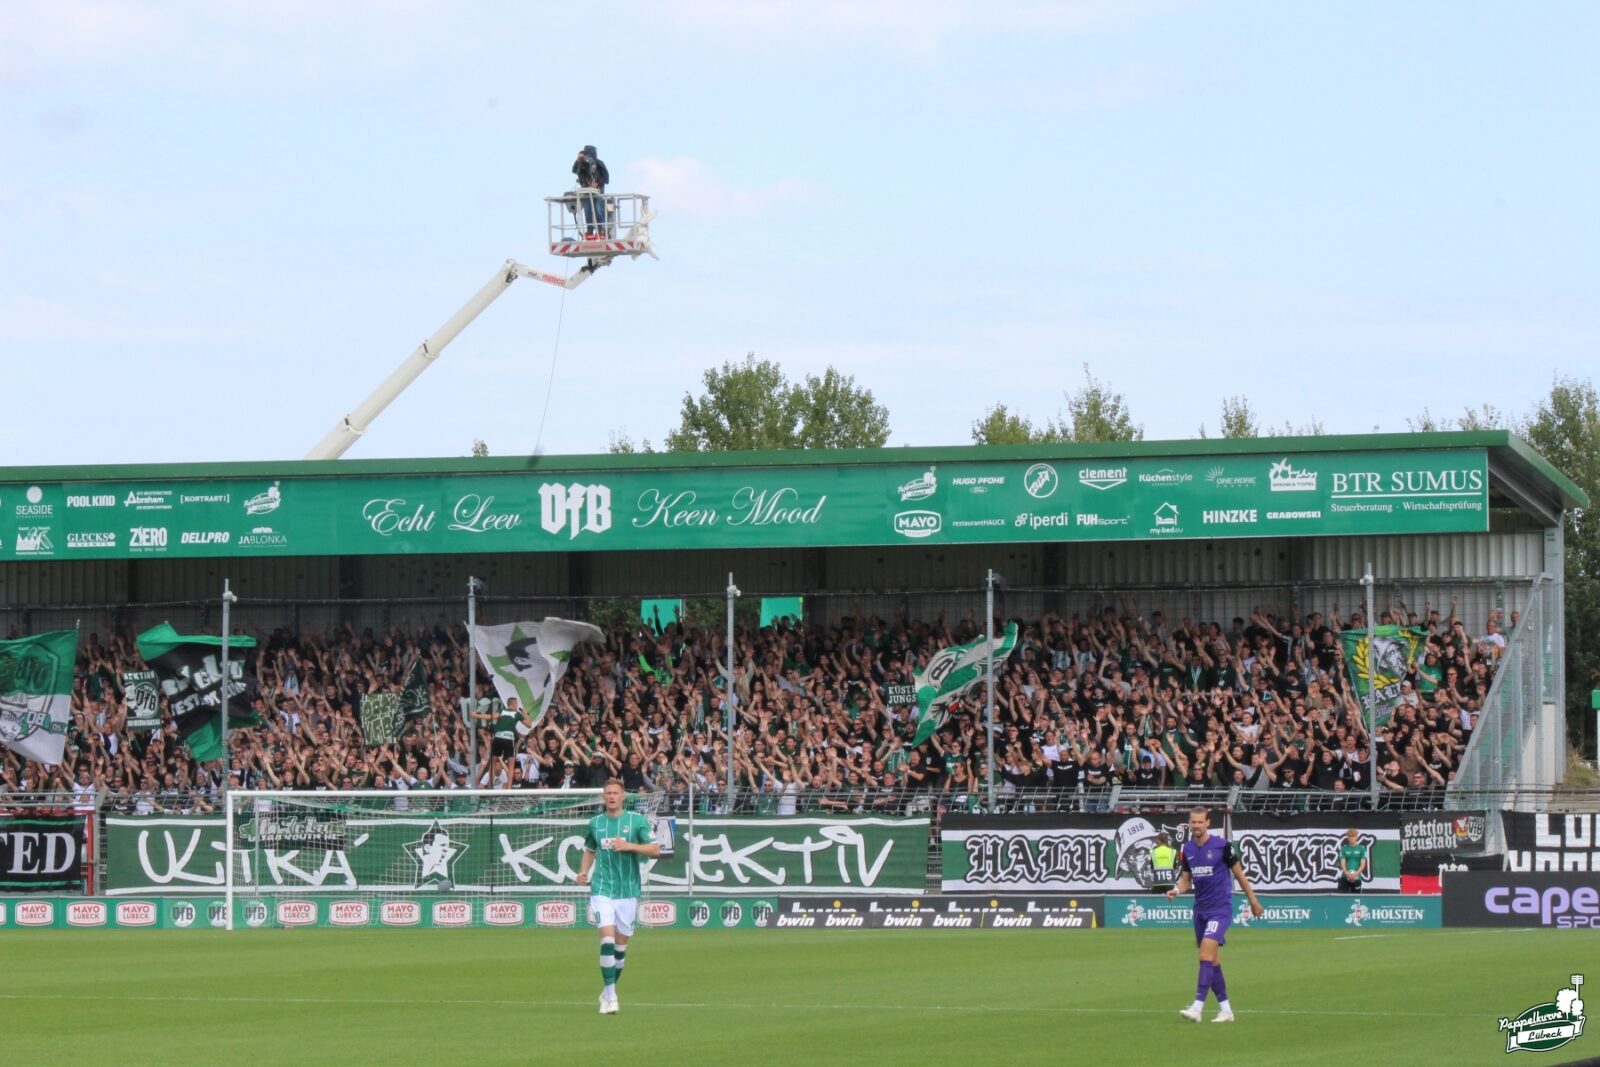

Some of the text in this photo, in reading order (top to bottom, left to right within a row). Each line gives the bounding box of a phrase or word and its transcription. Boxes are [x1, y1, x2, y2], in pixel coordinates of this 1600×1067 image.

[1079, 467, 1127, 479] clement
[1331, 469, 1482, 493] BTR SUMUS
[16, 505, 53, 515] SEASIDE
[538, 482, 611, 540] VfB
[632, 486, 826, 528] Keen Mood
[1331, 500, 1482, 513] Steuerberatung Wirtschaftsprüfung
[362, 499, 435, 536] Echt
[1029, 512, 1069, 530] iperdi
[1203, 509, 1257, 523] HINZKE
[1266, 511, 1320, 519] GRABOWSKI
[899, 517, 937, 528] MAYO
[181, 532, 230, 544] DELLPRO
[238, 535, 287, 545] JABLONKA
[888, 694, 917, 704] JUNGS
[1404, 819, 1452, 837] sektion
[1401, 833, 1457, 851] neustadt
[0, 832, 75, 874] ED
[1156, 871, 1172, 880] 115
[21, 905, 46, 913] MAYO
[73, 905, 98, 913] MAYO
[123, 905, 148, 913] MAYO
[172, 908, 194, 921] VfB
[689, 907, 708, 921] VfB
[721, 907, 740, 921] VfB
[1371, 909, 1423, 919] HOLSTEN
[776, 914, 816, 927] bwin
[825, 914, 864, 927] bwin
[884, 914, 923, 927] bwin
[933, 914, 972, 927] bwin
[992, 914, 1032, 927] bwin
[1043, 914, 1082, 927] bwin
